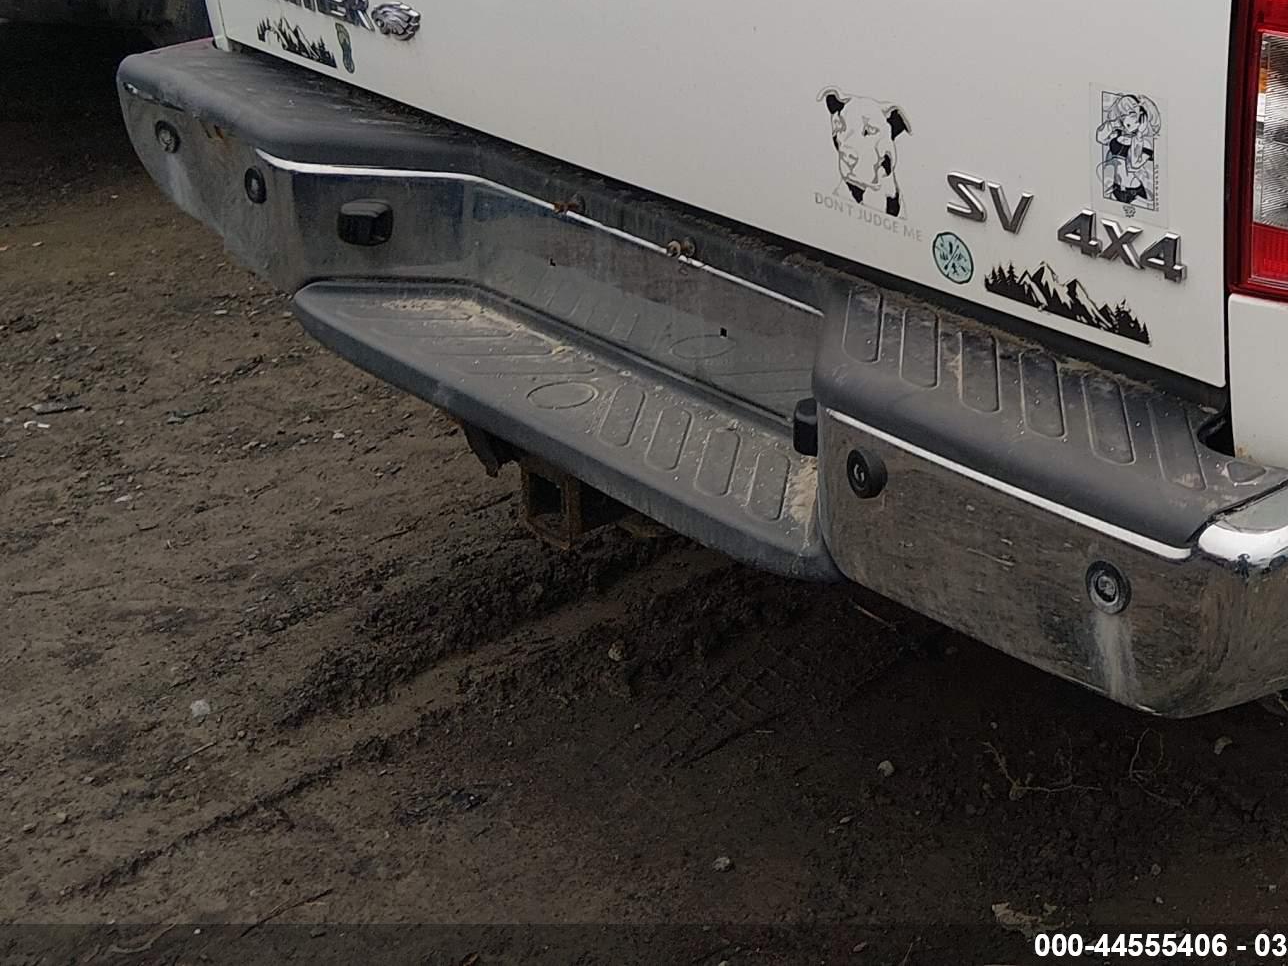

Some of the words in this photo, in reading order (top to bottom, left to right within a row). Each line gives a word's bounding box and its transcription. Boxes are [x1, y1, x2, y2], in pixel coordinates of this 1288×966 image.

[858, 209, 900, 234] JUDGE
[903, 224, 923, 243] ME
[946, 170, 1035, 235] SV
